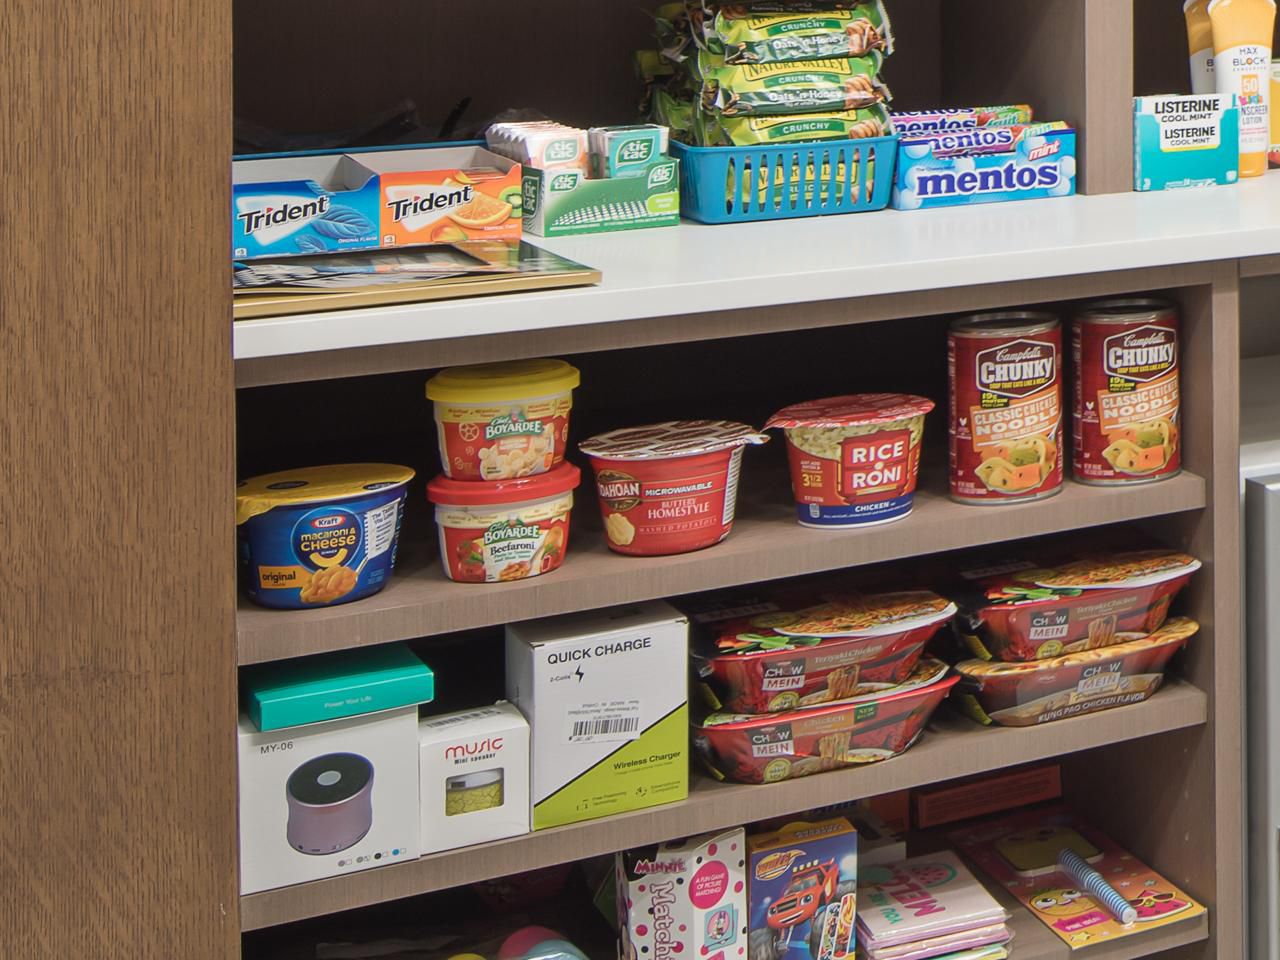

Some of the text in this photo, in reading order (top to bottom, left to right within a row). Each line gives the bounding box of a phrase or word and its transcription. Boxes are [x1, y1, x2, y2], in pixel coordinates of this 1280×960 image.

[1155, 98, 1220, 114] LISTERINE
[1161, 112, 1213, 123] COOL MINT
[1164, 126, 1216, 140] LISTERINE
[1194, 137, 1211, 145] MINT
[1027, 140, 1061, 161] mint
[917, 162, 1060, 198] mentos
[387, 185, 474, 222] Trident
[237, 196, 330, 234] Trident
[980, 360, 1054, 384] CHUNKY
[485, 420, 543, 439] BOYARDEE
[975, 409, 1058, 436] NOODLE
[851, 441, 904, 464] RICE
[644, 481, 713, 497] MICROWAVABLE
[647, 502, 711, 520] HOMESTYLE
[317, 516, 339, 528] Kraft
[490, 541, 537, 557] Beefaroni
[261, 571, 297, 585] original
[1033, 624, 1066, 638] MEIN
[547, 637, 652, 666] QUICK CHARGE
[767, 678, 802, 689] MEIN
[259, 741, 294, 756] MY-06
[444, 738, 504, 760] music
[613, 750, 682, 771] Wireless Charger
